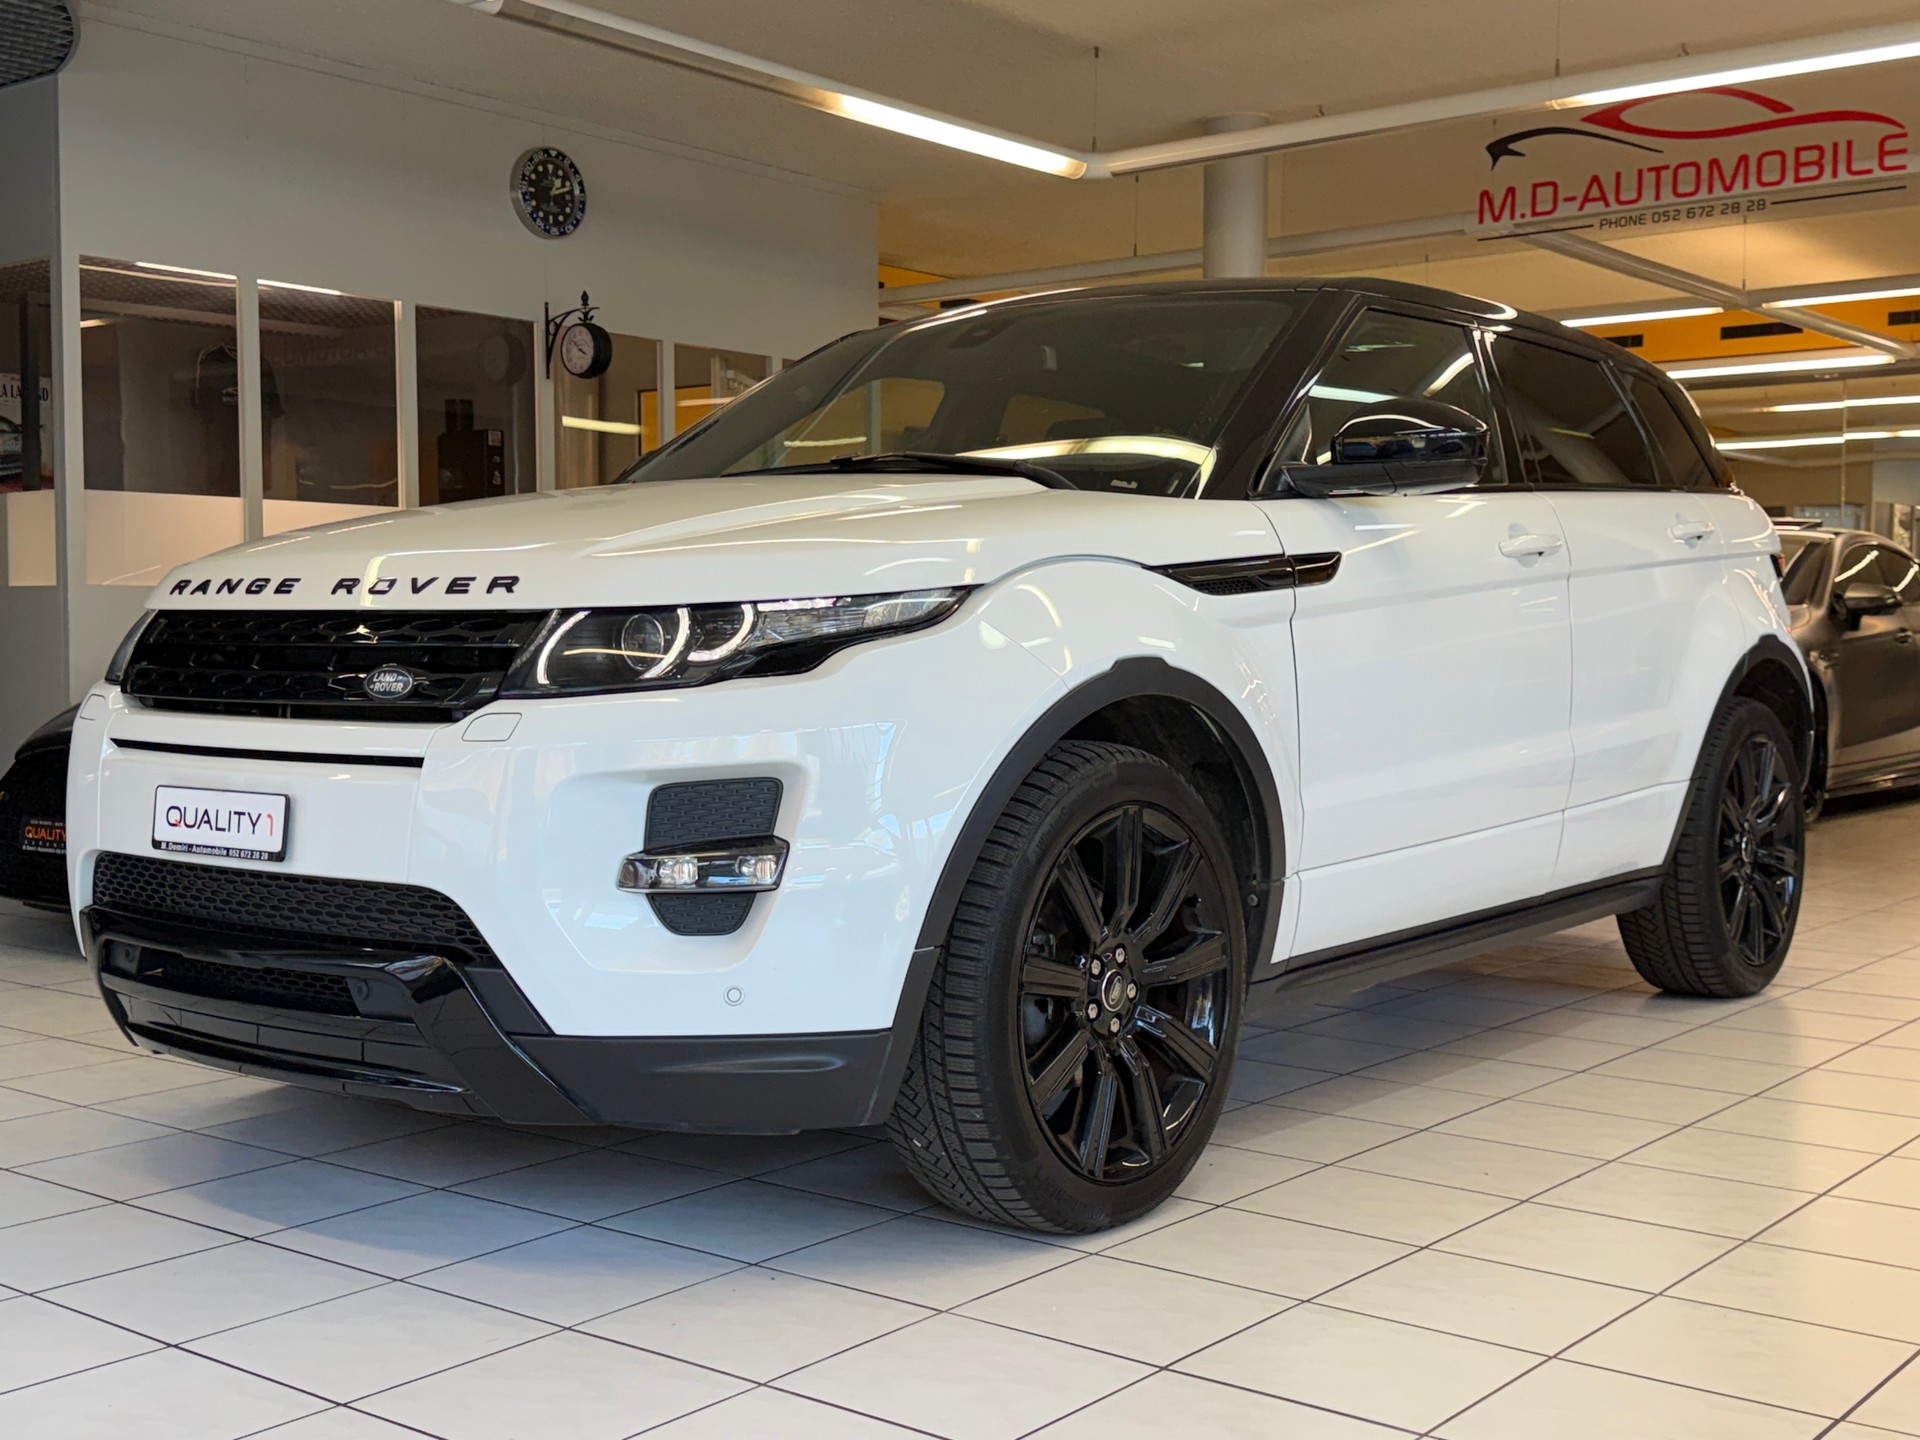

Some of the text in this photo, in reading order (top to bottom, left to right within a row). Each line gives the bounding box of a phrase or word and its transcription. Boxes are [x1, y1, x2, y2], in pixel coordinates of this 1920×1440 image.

[1478, 132, 1909, 225] M.D-AUTOMOBILE
[1600, 198, 1767, 230] PHONE 052 672 28 28
[170, 575, 520, 596] RANGE ROVER
[373, 672, 398, 682] LAND
[373, 682, 404, 692] ROVER
[229, 848, 240, 858] 052
